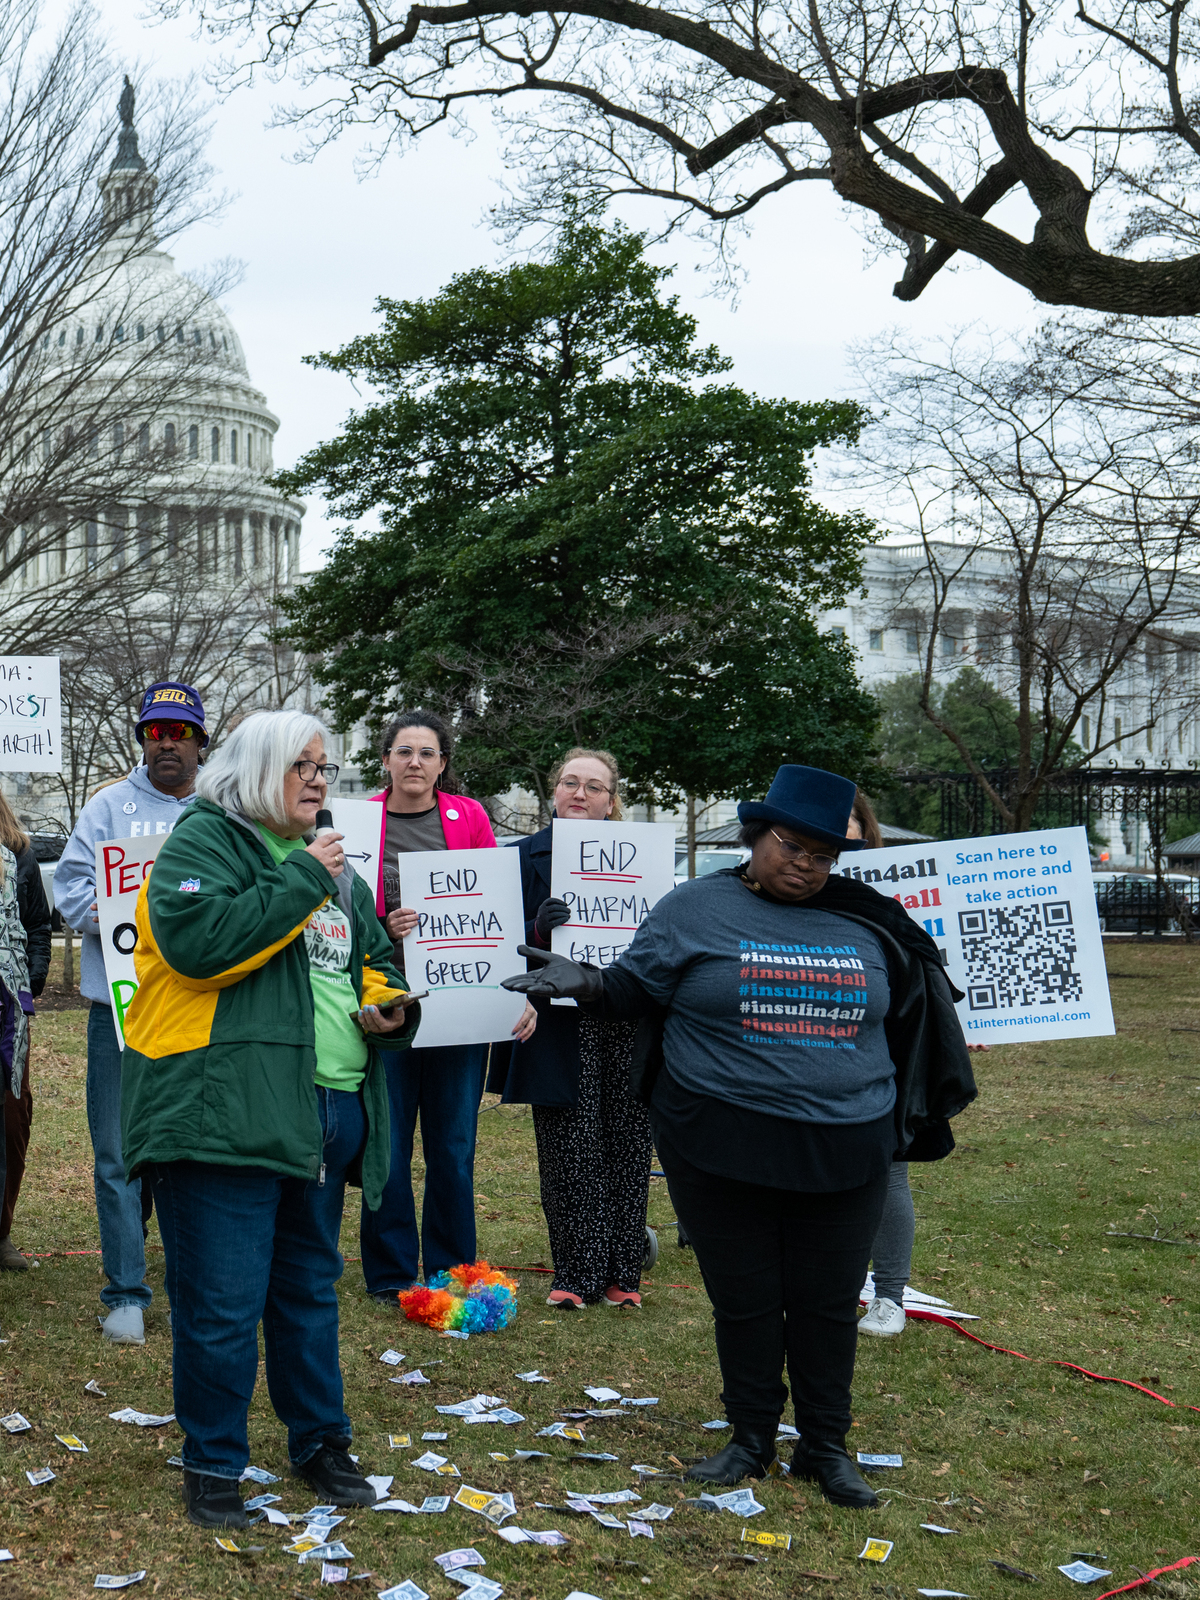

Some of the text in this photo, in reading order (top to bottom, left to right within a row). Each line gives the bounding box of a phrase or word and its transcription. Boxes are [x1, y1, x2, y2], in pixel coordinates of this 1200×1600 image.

[154, 691, 186, 702] SEIU
[580, 840, 637, 873] END
[956, 842, 1058, 866] Scan here to
[429, 869, 477, 894] END
[946, 860, 1072, 887] learn more and
[965, 883, 1058, 904] take action
[562, 892, 650, 923] PHARMA
[418, 910, 503, 939] PHARMA
[570, 941, 632, 966] GREE
[739, 940, 858, 955] #insulin4all
[740, 952, 864, 971] #insulin4all
[425, 959, 491, 986] GREED
[740, 966, 867, 987] #insulin4all
[739, 983, 867, 1004] #insulin4all
[739, 1001, 866, 1021] #insulin4all
[967, 1010, 1091, 1029] t1international.com
[741, 1018, 858, 1038] #insulin4all
[757, 1535, 775, 1543] 500
